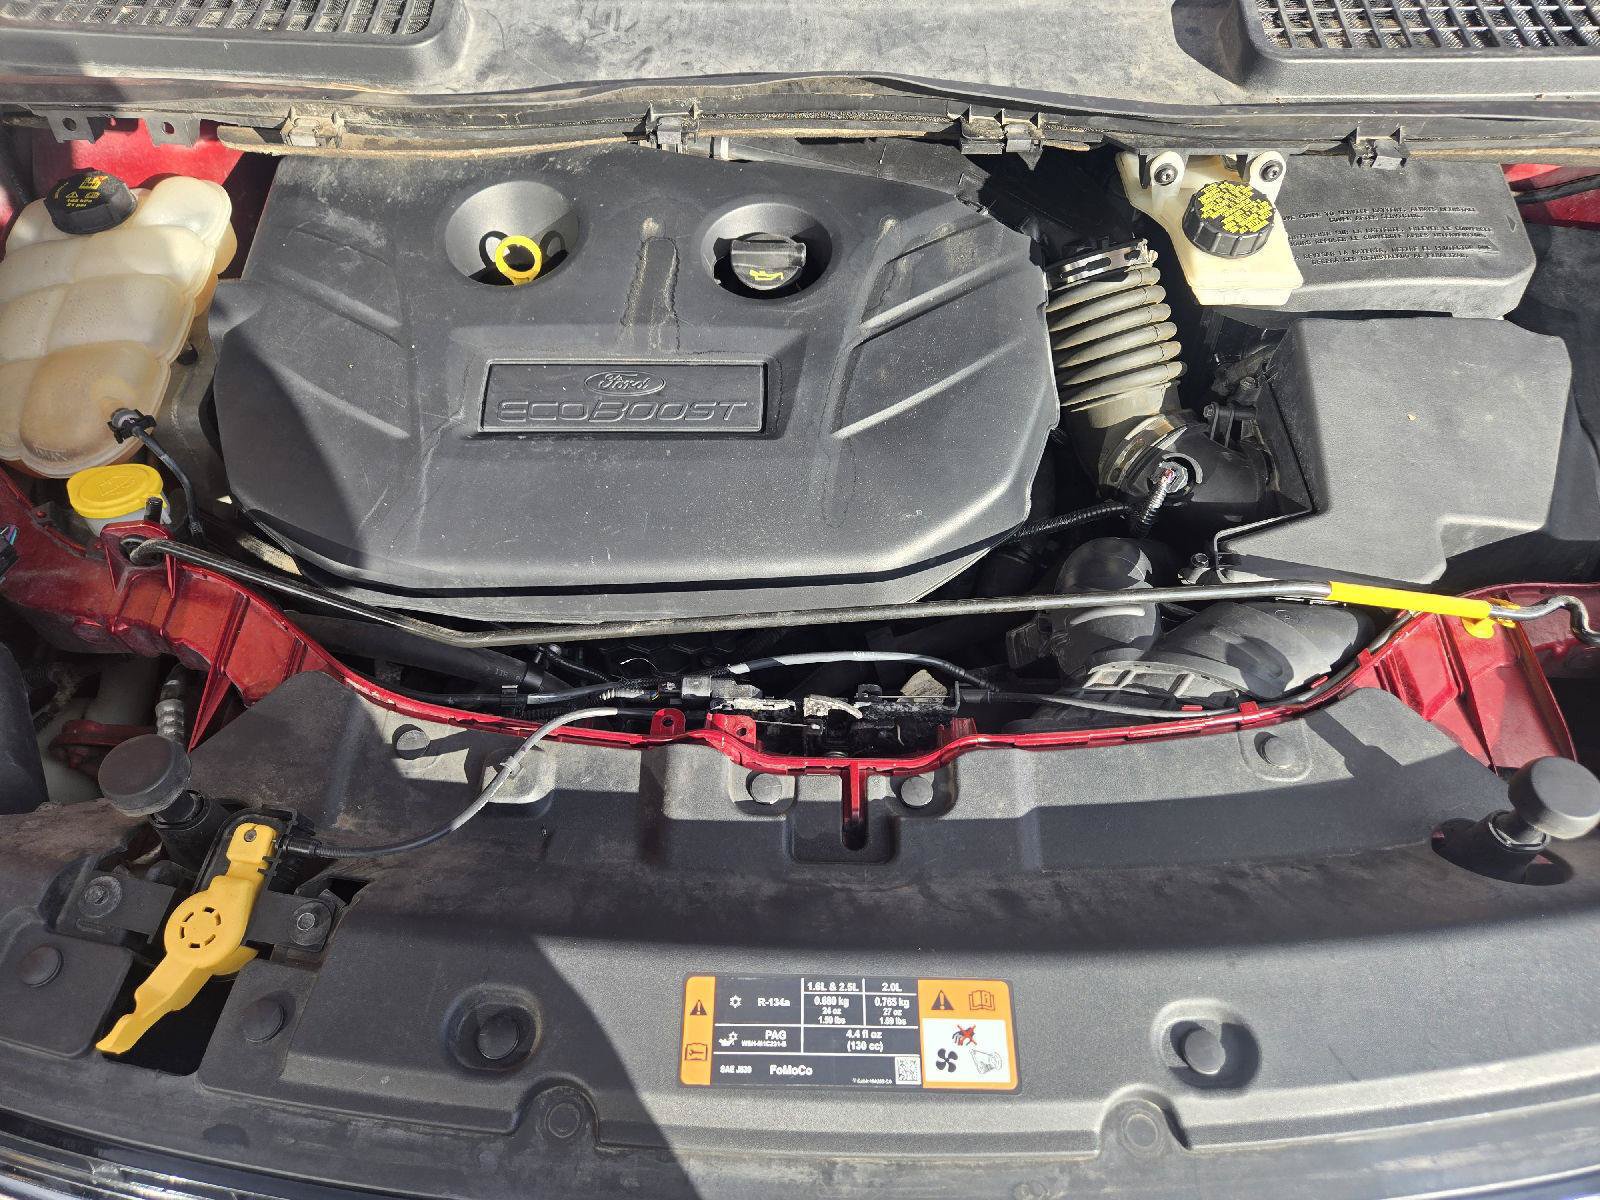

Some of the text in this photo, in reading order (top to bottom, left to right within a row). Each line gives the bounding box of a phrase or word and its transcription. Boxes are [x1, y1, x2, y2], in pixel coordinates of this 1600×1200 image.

[599, 372, 649, 391] Ford
[499, 401, 747, 422] ECOBOOST
[807, 982, 860, 992] 1.6L & 2.5L
[881, 983, 903, 992] 2.0L
[838, 997, 850, 1008] kg
[898, 998, 910, 1009] kg
[765, 1029, 787, 1041] PAG
[846, 1029, 861, 1039] 4.4
[870, 1030, 883, 1039] oz
[769, 1064, 813, 1076] FoMoCo
